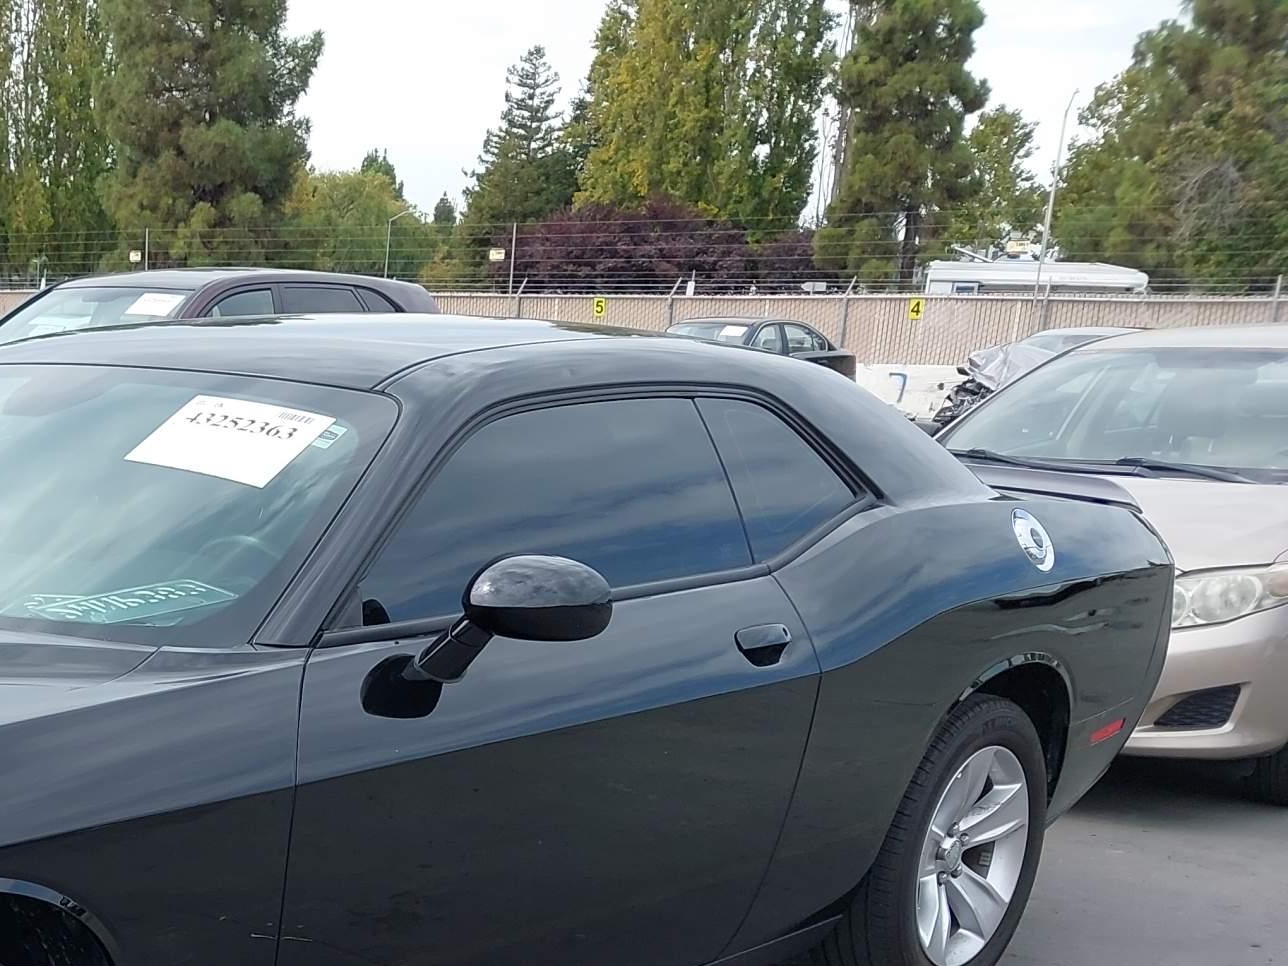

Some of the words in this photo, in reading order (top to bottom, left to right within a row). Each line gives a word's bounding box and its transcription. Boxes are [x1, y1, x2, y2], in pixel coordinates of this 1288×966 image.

[595, 300, 604, 314] 5
[910, 301, 921, 316] 4
[889, 372, 907, 403] 7
[186, 412, 298, 440] 43252363
